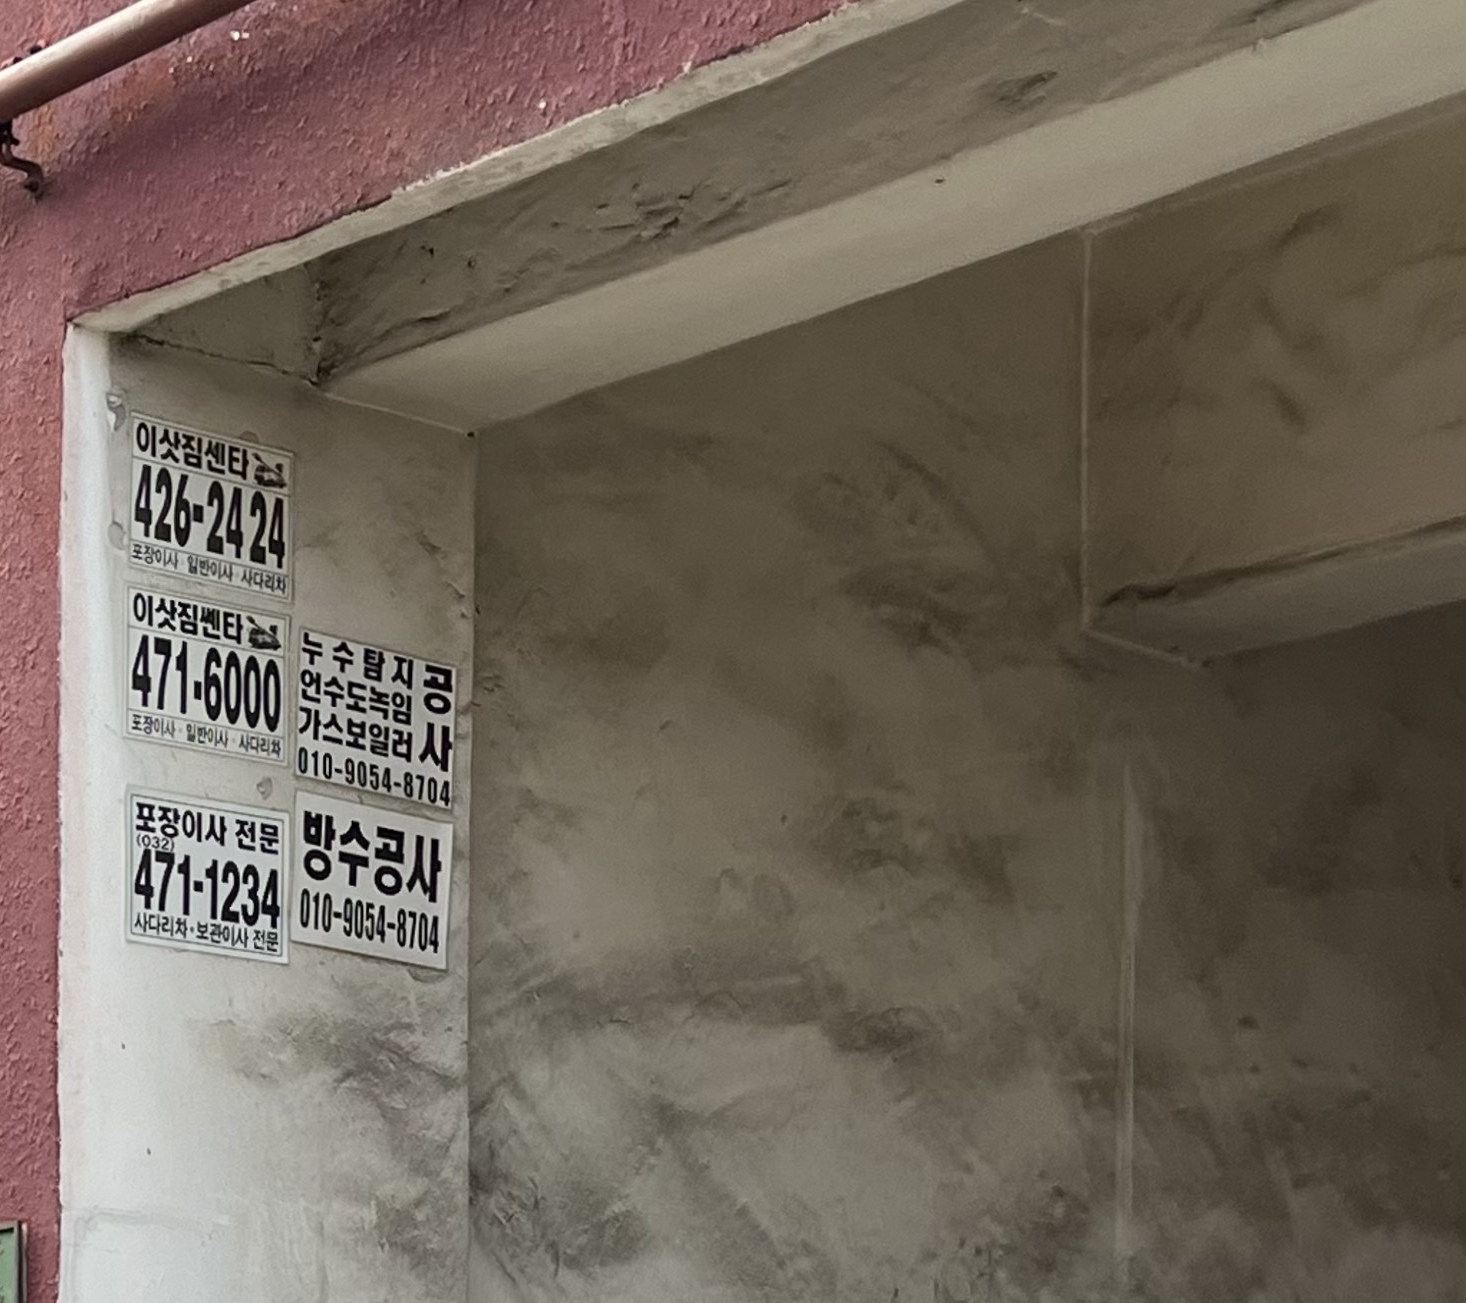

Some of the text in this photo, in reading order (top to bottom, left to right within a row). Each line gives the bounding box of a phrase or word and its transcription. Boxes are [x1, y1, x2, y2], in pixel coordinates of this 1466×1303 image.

[136, 422, 249, 480] 이삿짐센타
[131, 543, 179, 569] 포장이사
[241, 568, 287, 594] 사다리차
[134, 593, 244, 645] 이삿짐쎈타
[132, 634, 281, 733] 471-6000
[300, 669, 413, 726] 언수도녹임
[131, 714, 282, 758] 포장이사 일반이사 사다리차
[298, 706, 413, 763] 가스보일러
[298, 747, 451, 807] 010-9054-8704
[136, 802, 280, 855] 포장이사 전문
[136, 834, 175, 851] (032)
[303, 810, 442, 903] 방수공사
[134, 849, 281, 929] 471-1234
[253, 929, 279, 952] 전문
[300, 888, 440, 954] 010-9054-8704
